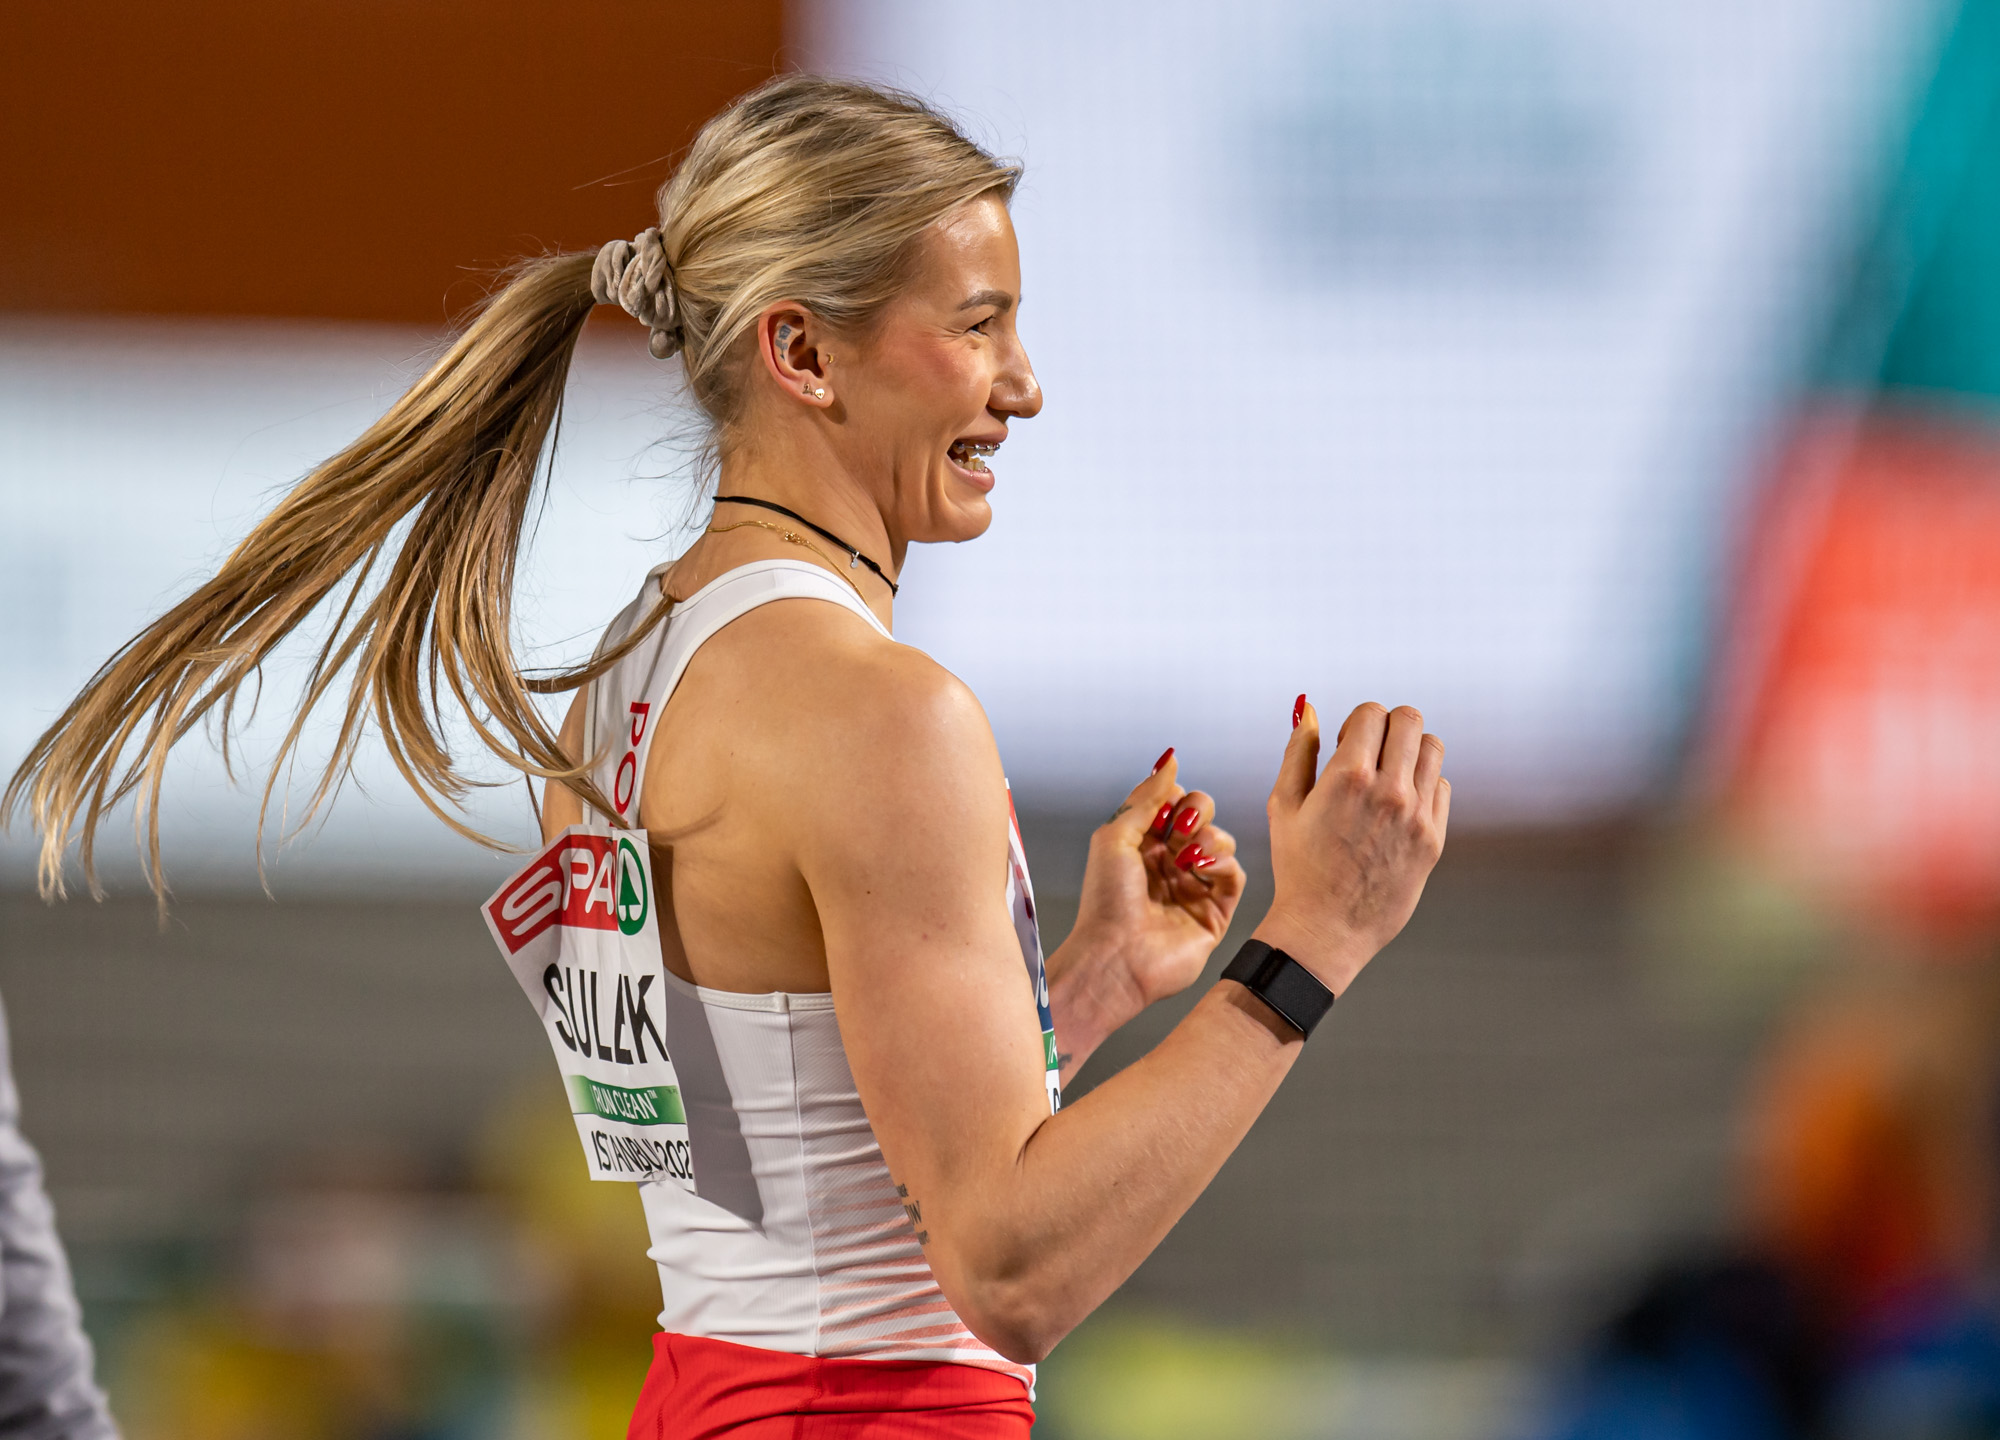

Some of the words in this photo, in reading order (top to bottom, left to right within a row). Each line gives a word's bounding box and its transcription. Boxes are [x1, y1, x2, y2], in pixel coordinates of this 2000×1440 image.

[501, 847, 616, 936] SPA
[592, 1085, 618, 1116] RUN
[591, 1130, 664, 1173] ISTANBU
[653, 1139, 694, 1180] 202
